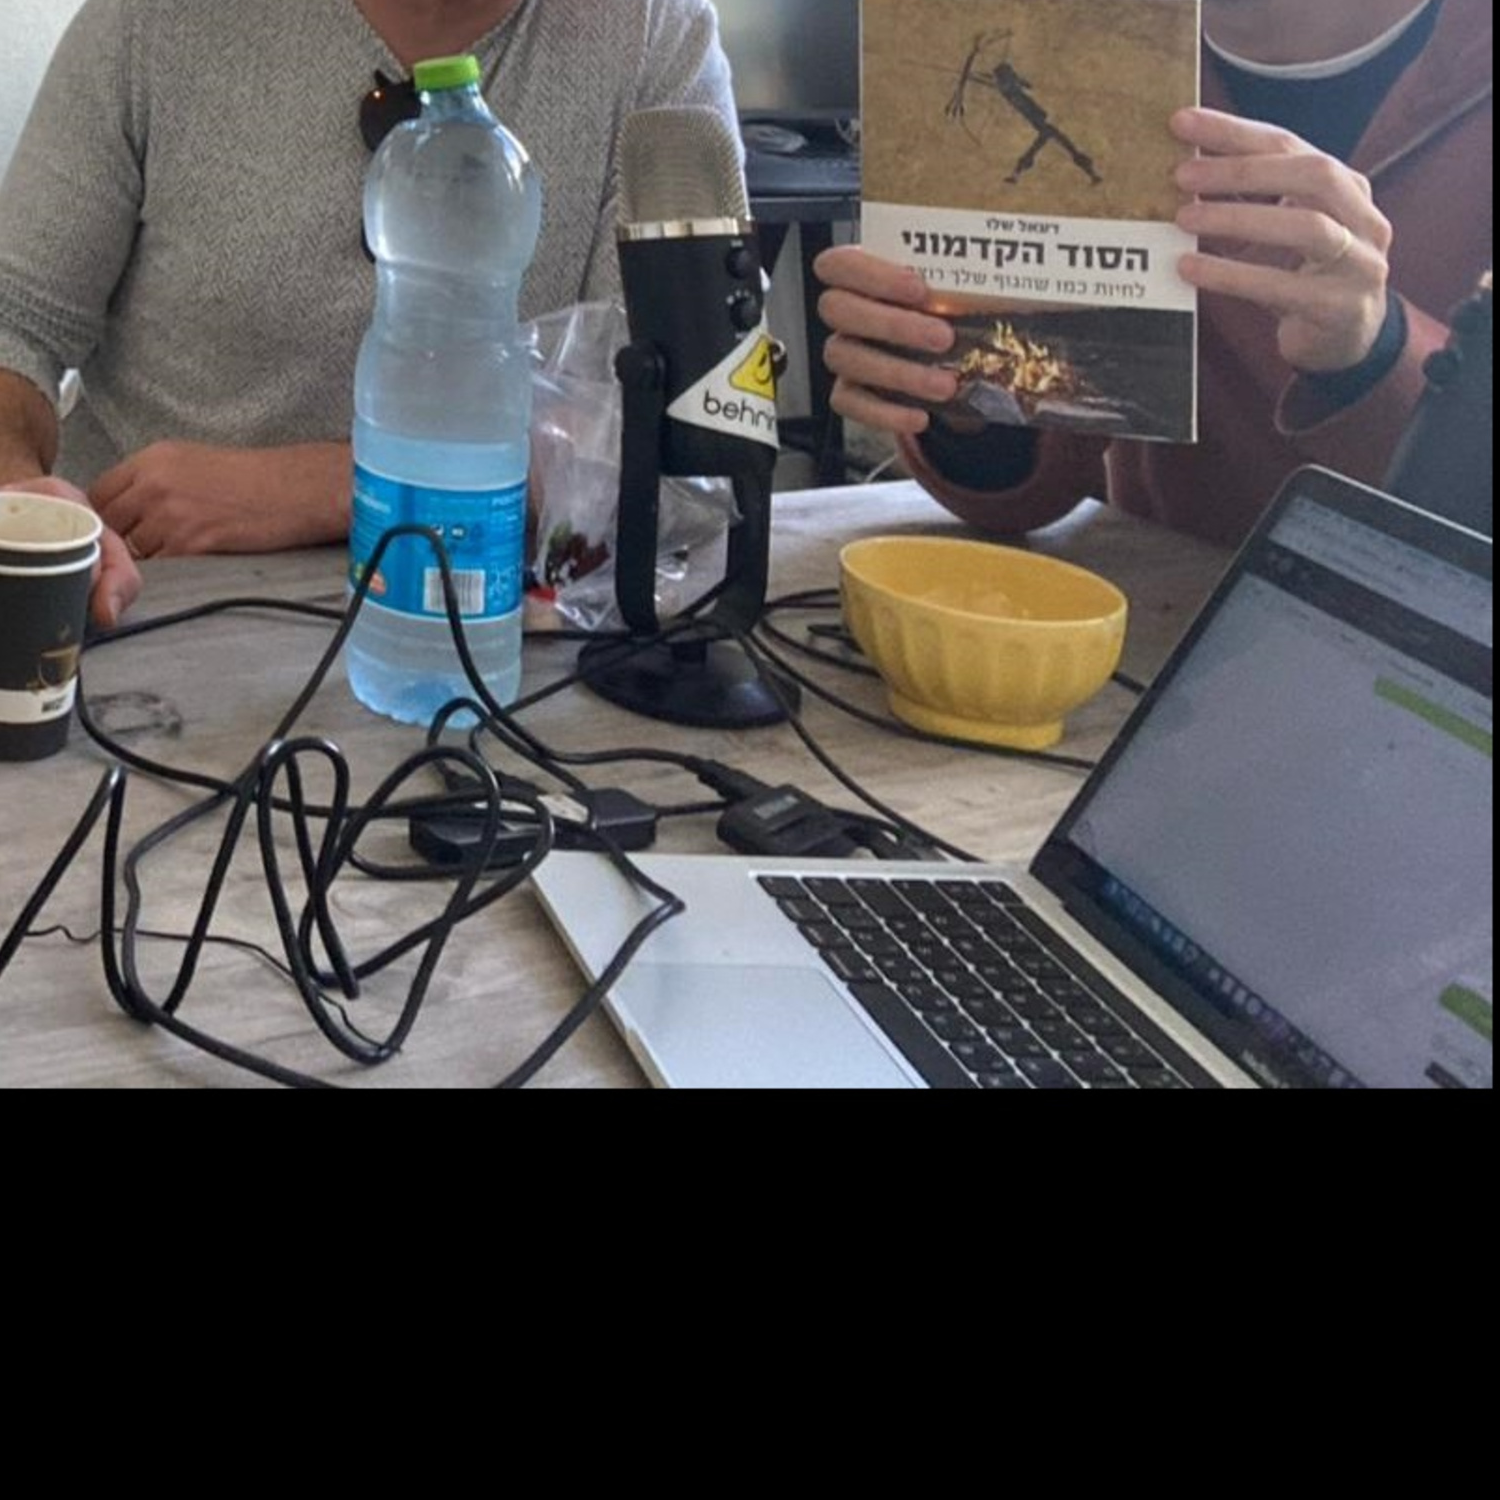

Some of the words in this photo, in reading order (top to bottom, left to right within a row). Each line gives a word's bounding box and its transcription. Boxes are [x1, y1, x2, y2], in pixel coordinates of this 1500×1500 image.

[901, 230, 1045, 268] הקדמוני
[1057, 243, 1150, 272] הסוד
[953, 267, 987, 287] שלך
[993, 274, 1050, 291] שהגוף
[1056, 280, 1087, 295] כמו
[1093, 280, 1146, 298] לחיות
